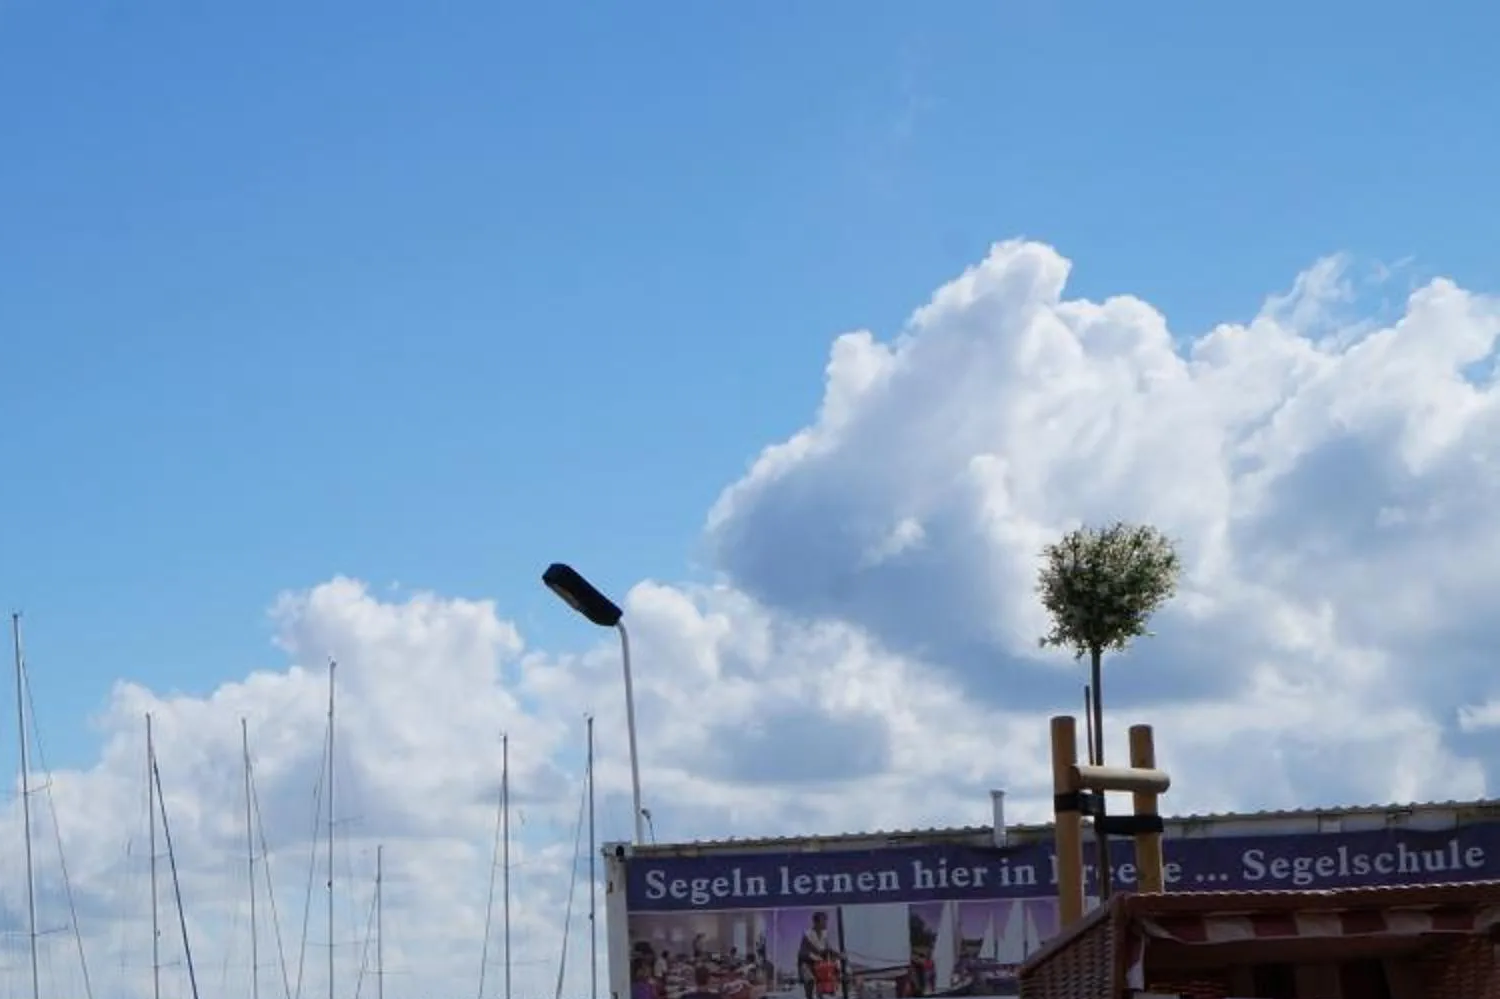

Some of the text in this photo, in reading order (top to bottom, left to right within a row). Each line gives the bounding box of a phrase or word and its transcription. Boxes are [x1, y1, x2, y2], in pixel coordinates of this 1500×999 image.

[645, 869, 768, 904] Segeln
[780, 866, 900, 895] lernen
[913, 857, 988, 889] hier
[991, 860, 1037, 885] in
[1242, 839, 1486, 884] Segelschule
